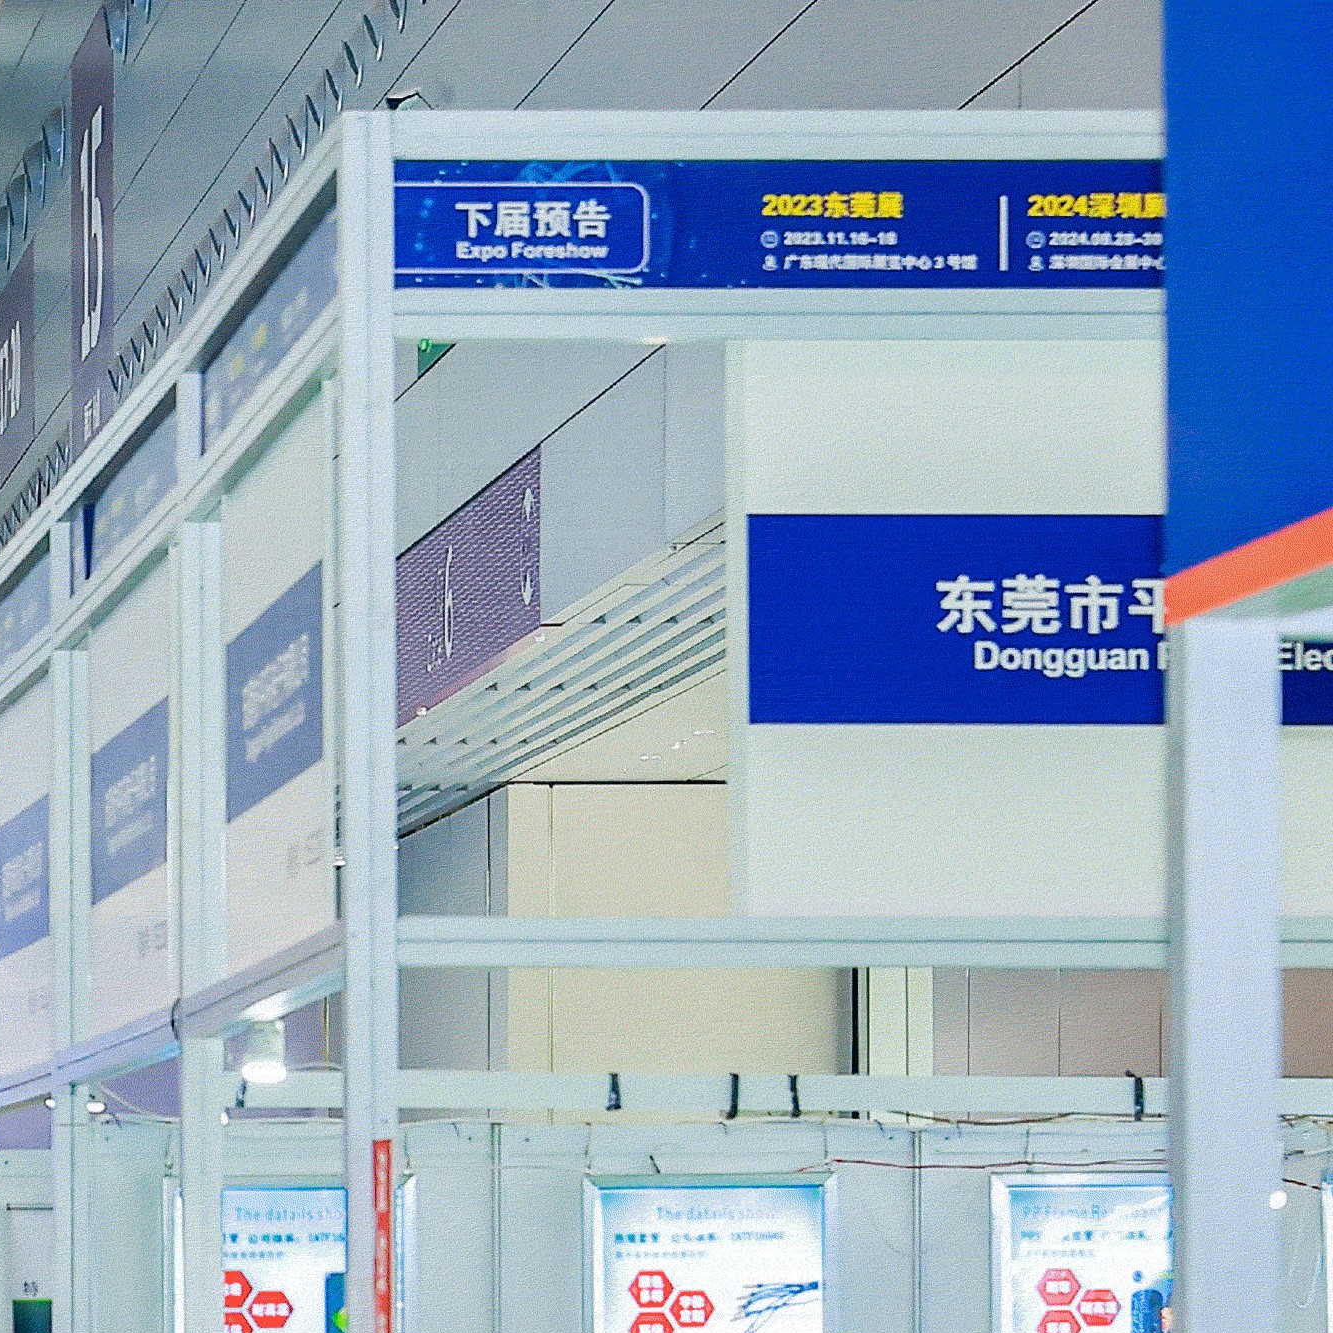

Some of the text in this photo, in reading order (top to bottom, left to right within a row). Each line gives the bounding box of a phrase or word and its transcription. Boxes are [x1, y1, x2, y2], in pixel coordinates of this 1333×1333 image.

[455, 200, 610, 238] 下届预告
[455, 242, 608, 262] Expo Foreshow
[974, 640, 1150, 678] Dongguan
